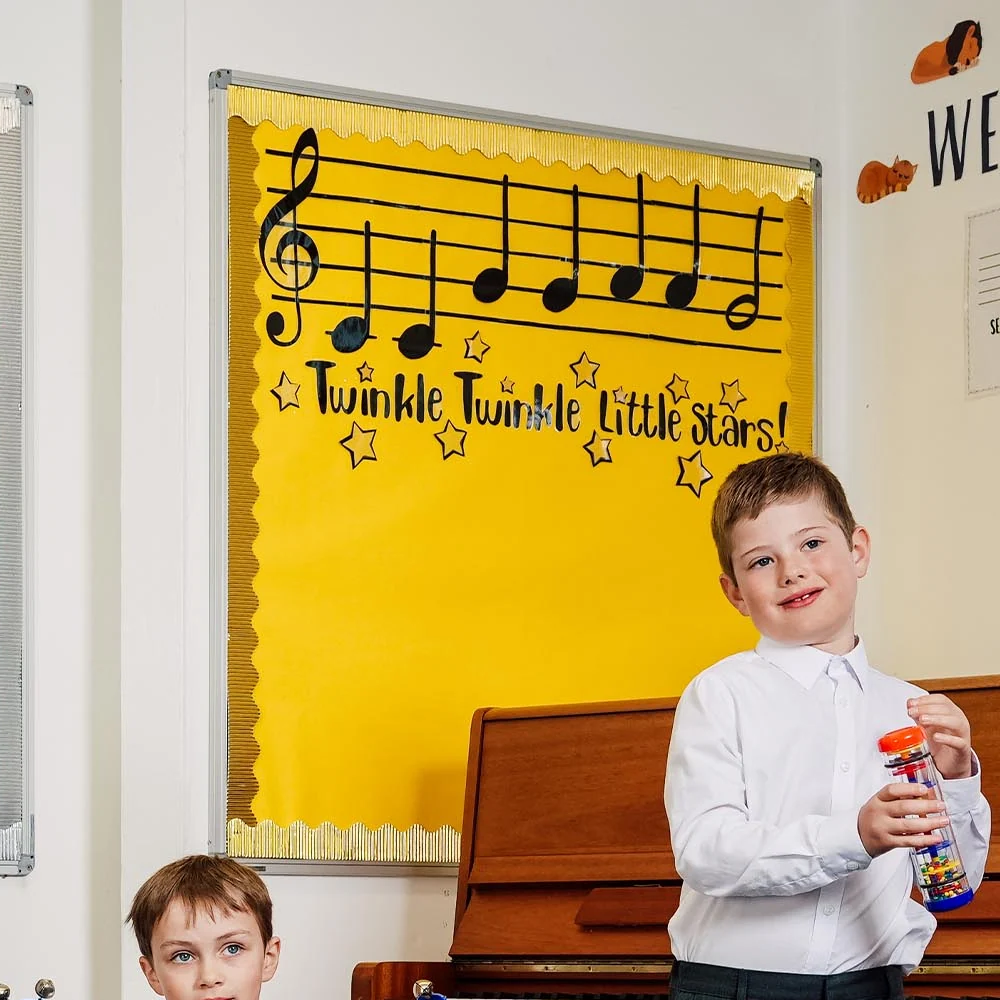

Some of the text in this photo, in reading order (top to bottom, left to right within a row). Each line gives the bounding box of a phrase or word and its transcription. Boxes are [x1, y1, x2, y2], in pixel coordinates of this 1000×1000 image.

[305, 360, 443, 422] Twinkle
[453, 371, 581, 432] Twinkle
[600, 388, 682, 442] Little
